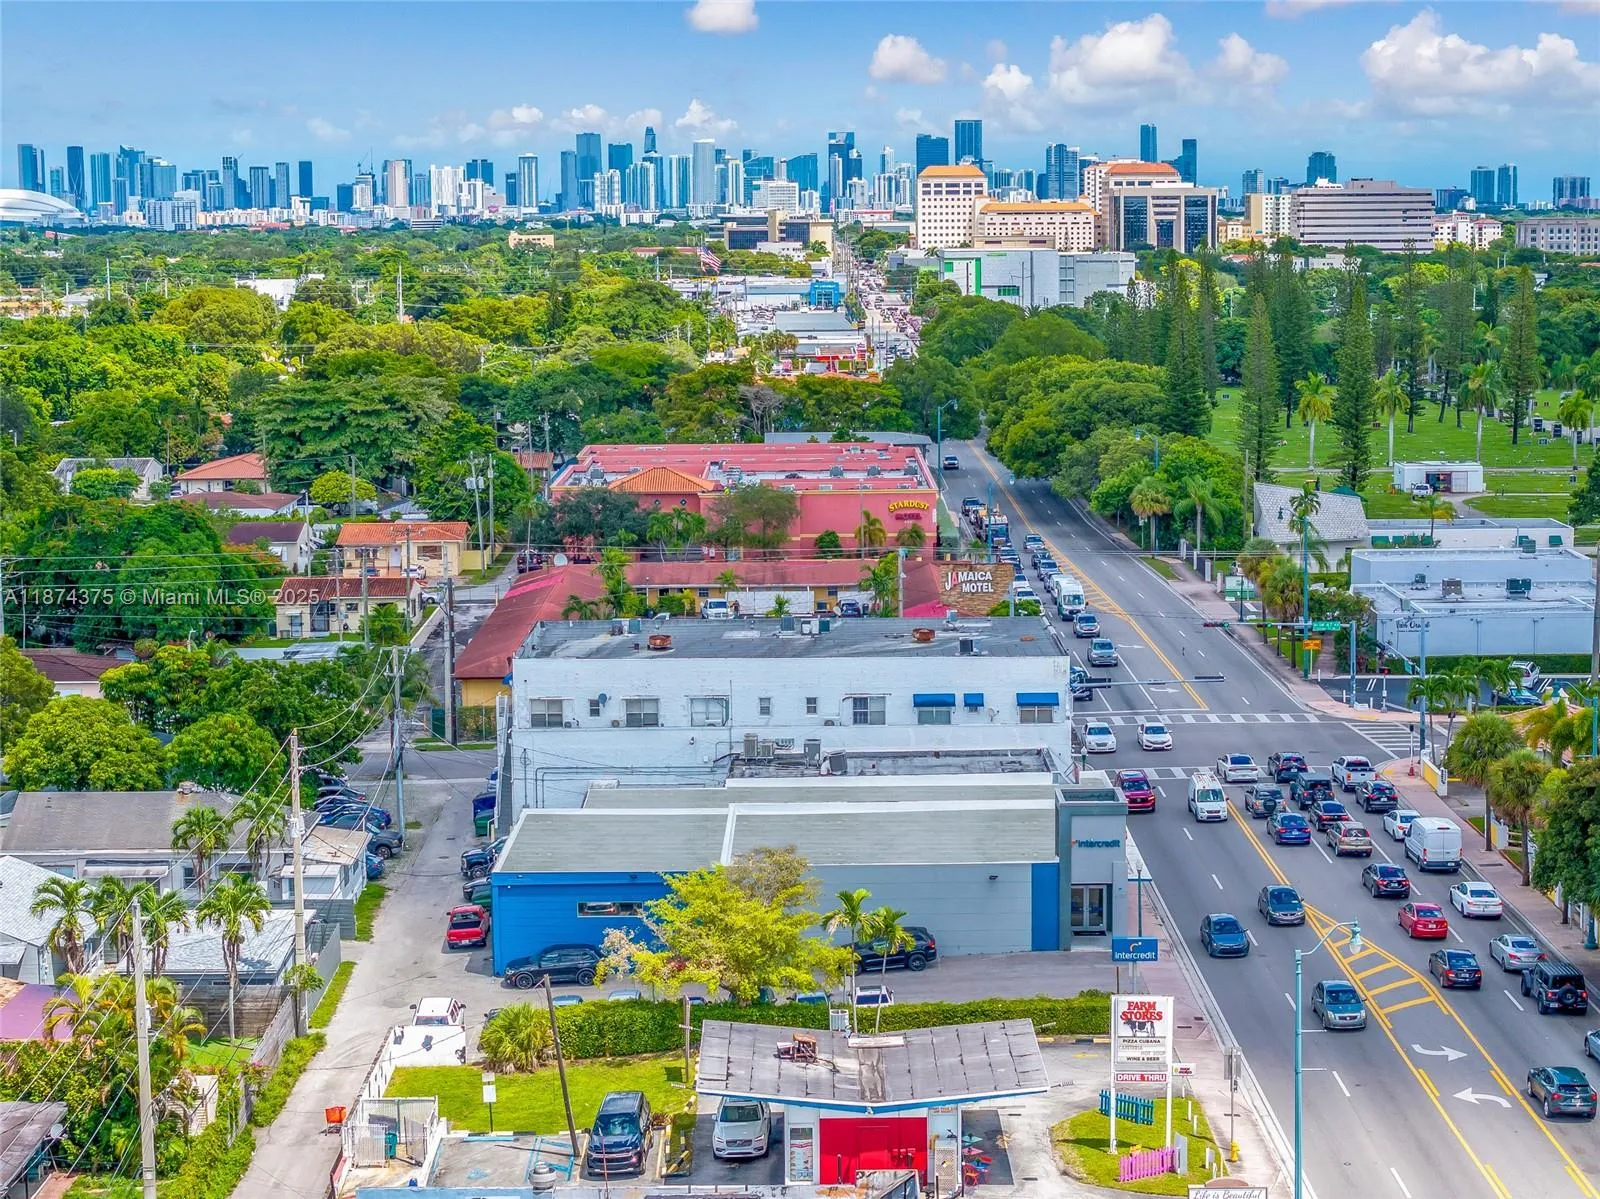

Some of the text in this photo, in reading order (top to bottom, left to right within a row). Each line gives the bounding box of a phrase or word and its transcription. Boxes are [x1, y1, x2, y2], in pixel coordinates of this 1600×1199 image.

[888, 500, 930, 512] STARDUST
[945, 570, 992, 591] JAMAICA
[962, 583, 994, 593] MOTEL
[1078, 839, 1121, 848] intercredit
[1114, 951, 1156, 960] intercredit
[1127, 1001, 1157, 1011] FARM
[1120, 1011, 1163, 1021] STORES
[1194, 1189, 1262, 1199] Life is Beautiful
